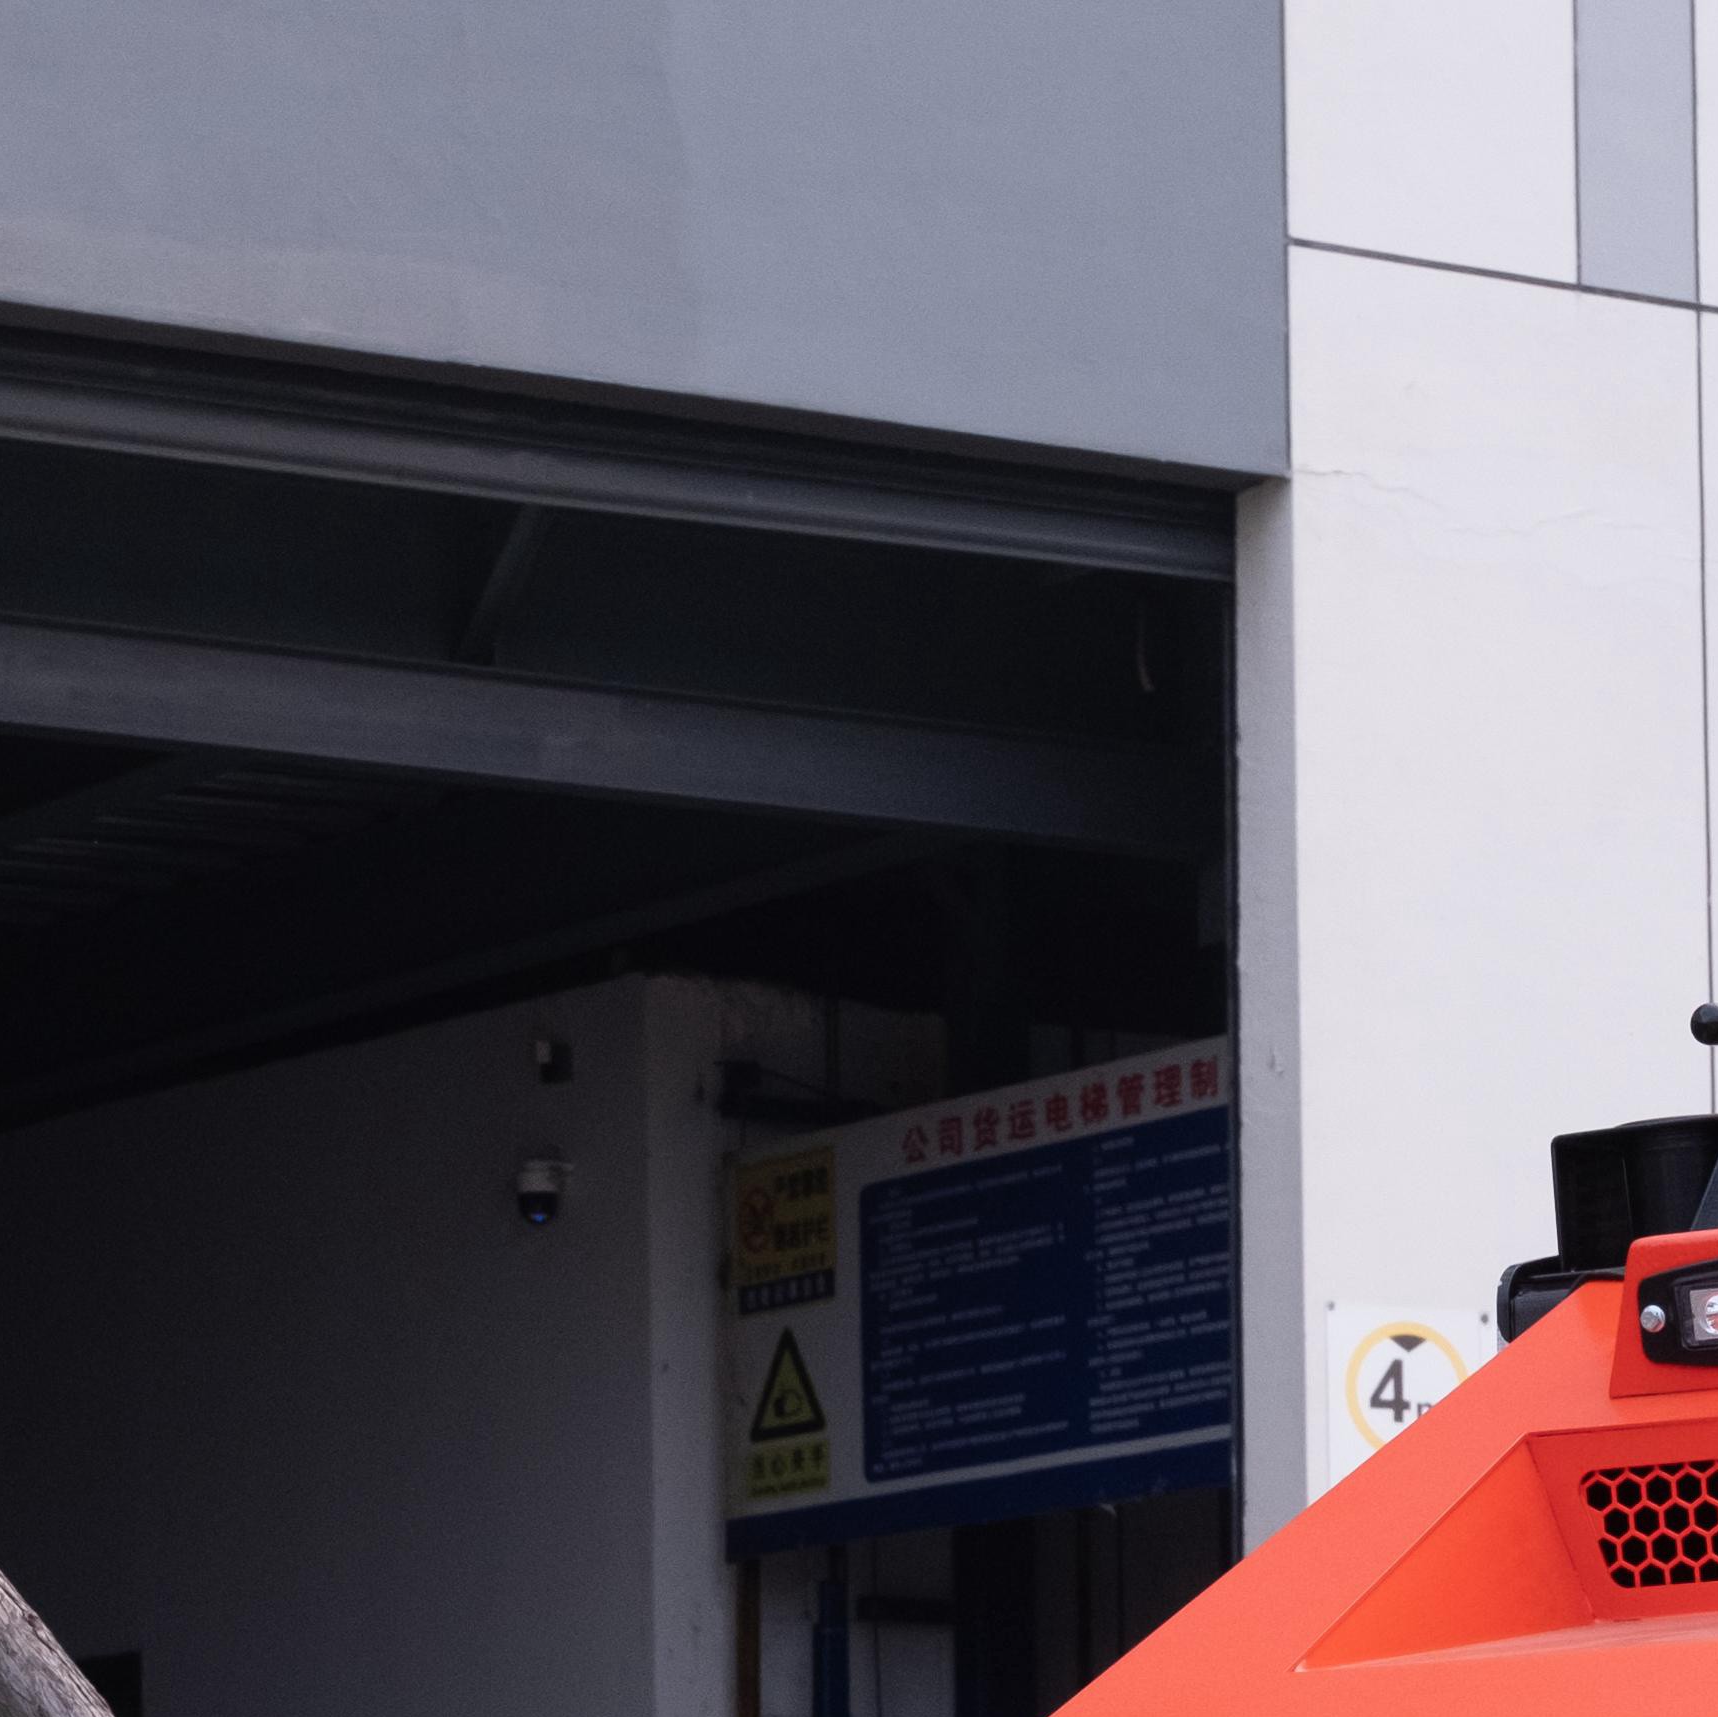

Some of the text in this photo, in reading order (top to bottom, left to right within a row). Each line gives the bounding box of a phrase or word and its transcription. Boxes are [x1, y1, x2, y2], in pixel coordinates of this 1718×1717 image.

[900, 1054, 1220, 1164] 公司货运电梯管理制
[1369, 1358, 1433, 1423] 4
